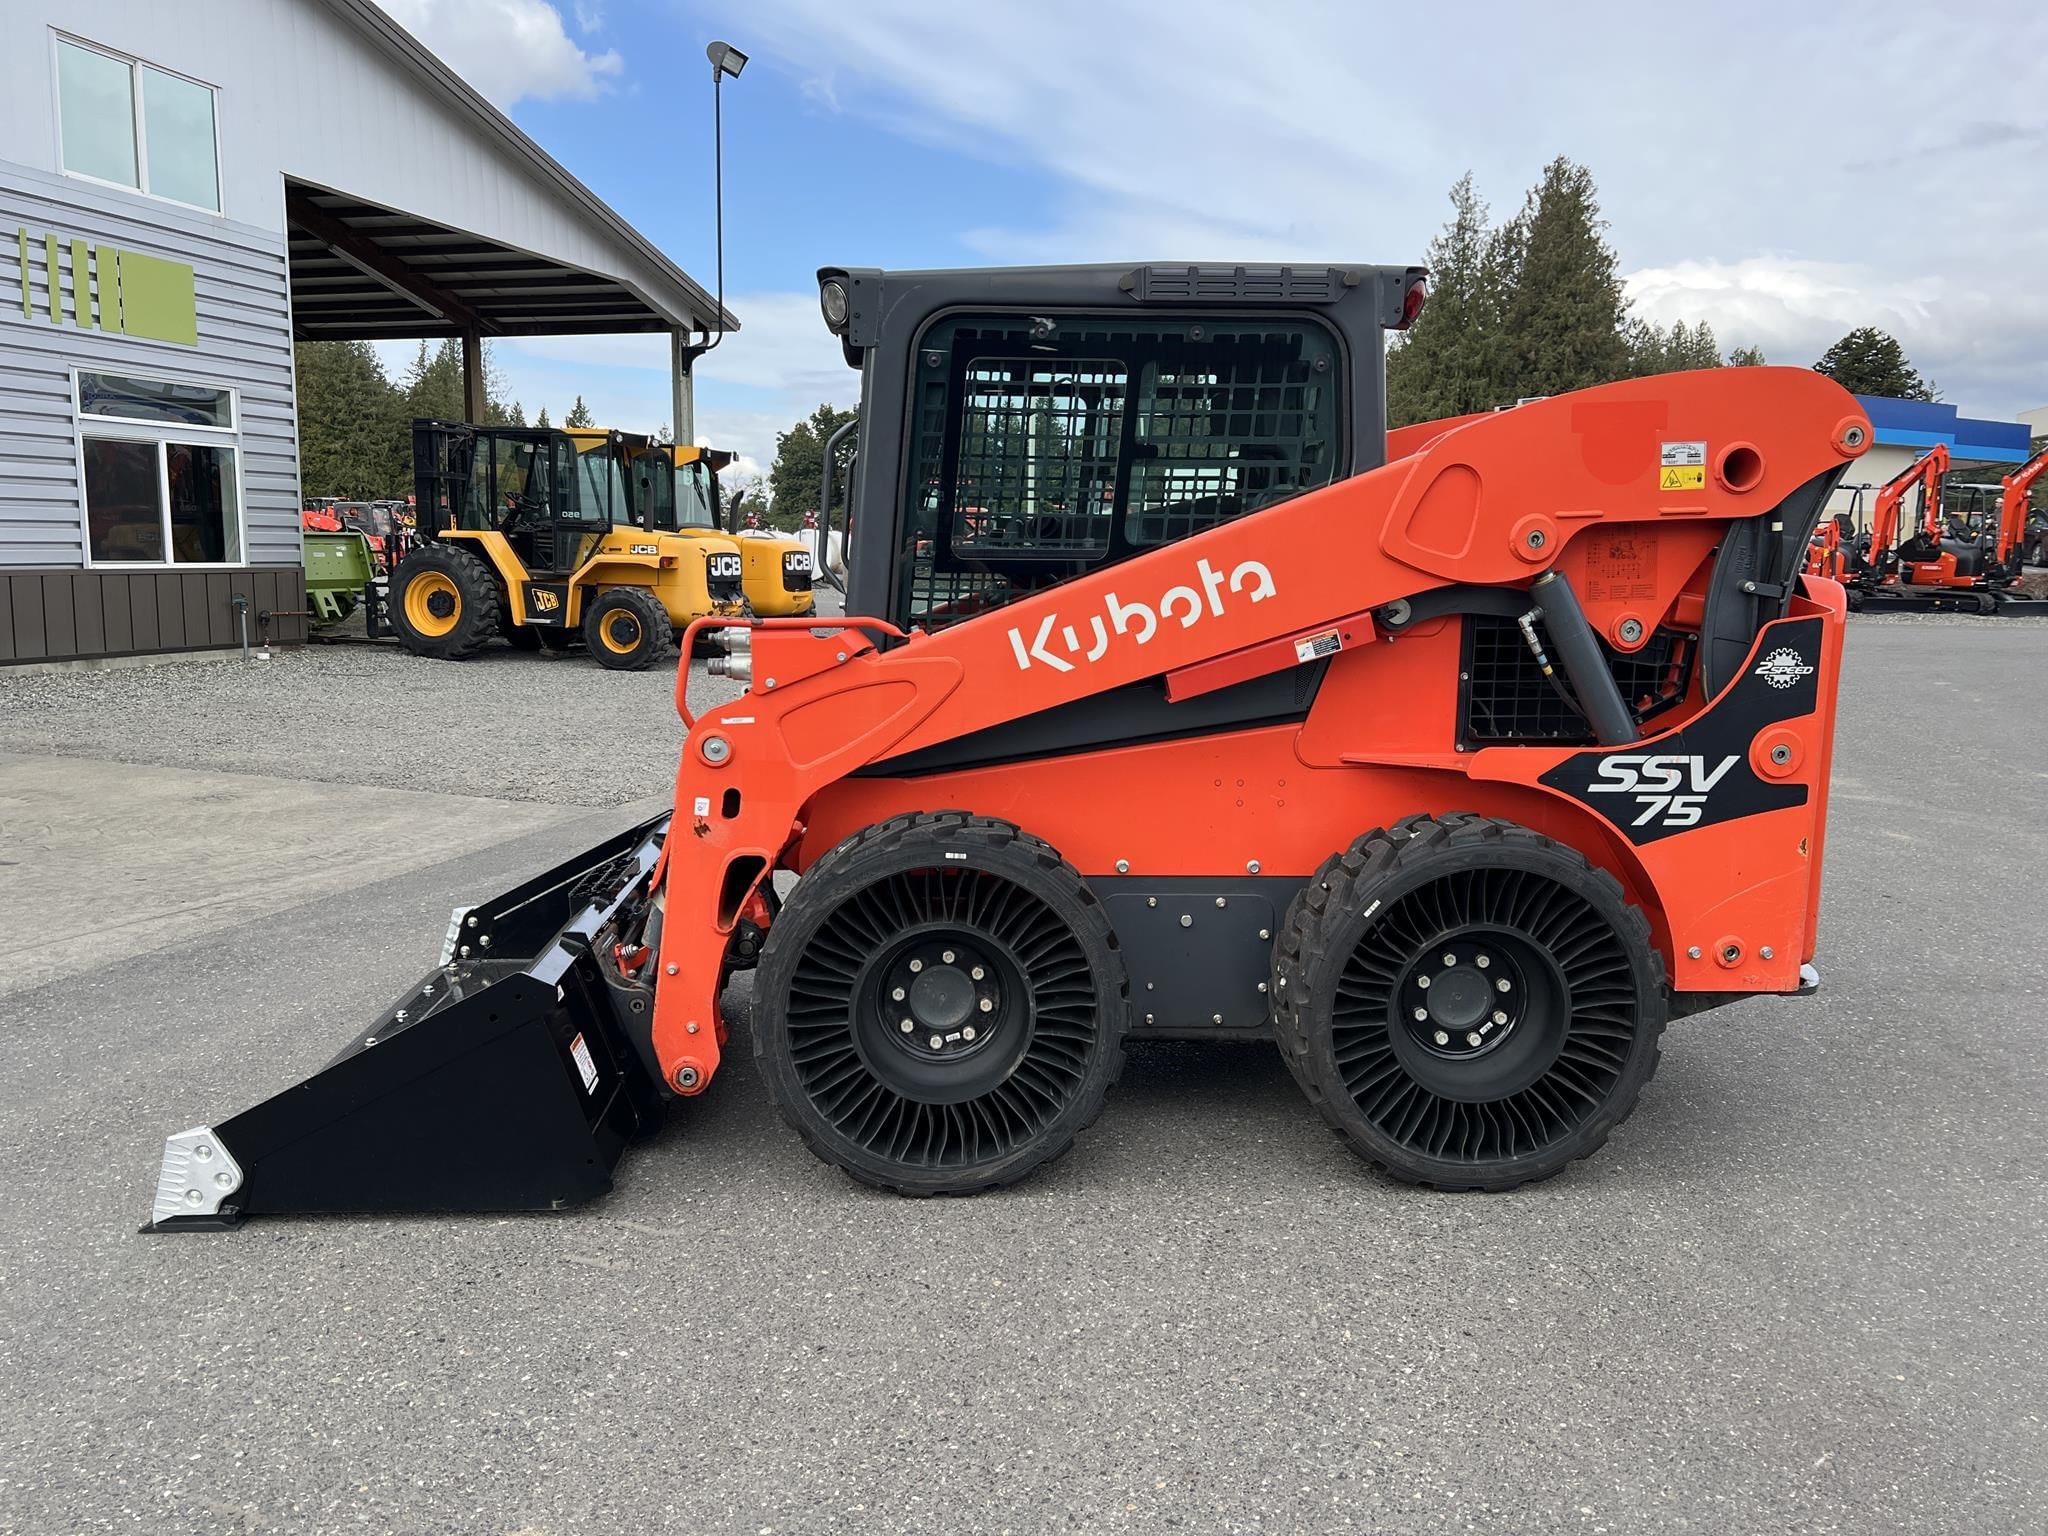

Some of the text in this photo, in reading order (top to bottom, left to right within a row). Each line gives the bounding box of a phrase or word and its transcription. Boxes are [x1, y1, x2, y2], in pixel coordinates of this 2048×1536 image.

[631, 546, 657, 554] JCB
[711, 556, 741, 576] JCB
[785, 554, 811, 570] JCB
[536, 591, 558, 611] JCB
[1007, 558, 1277, 672] Kubota
[1587, 755, 1741, 792] SSV
[1630, 795, 1708, 826] 75
